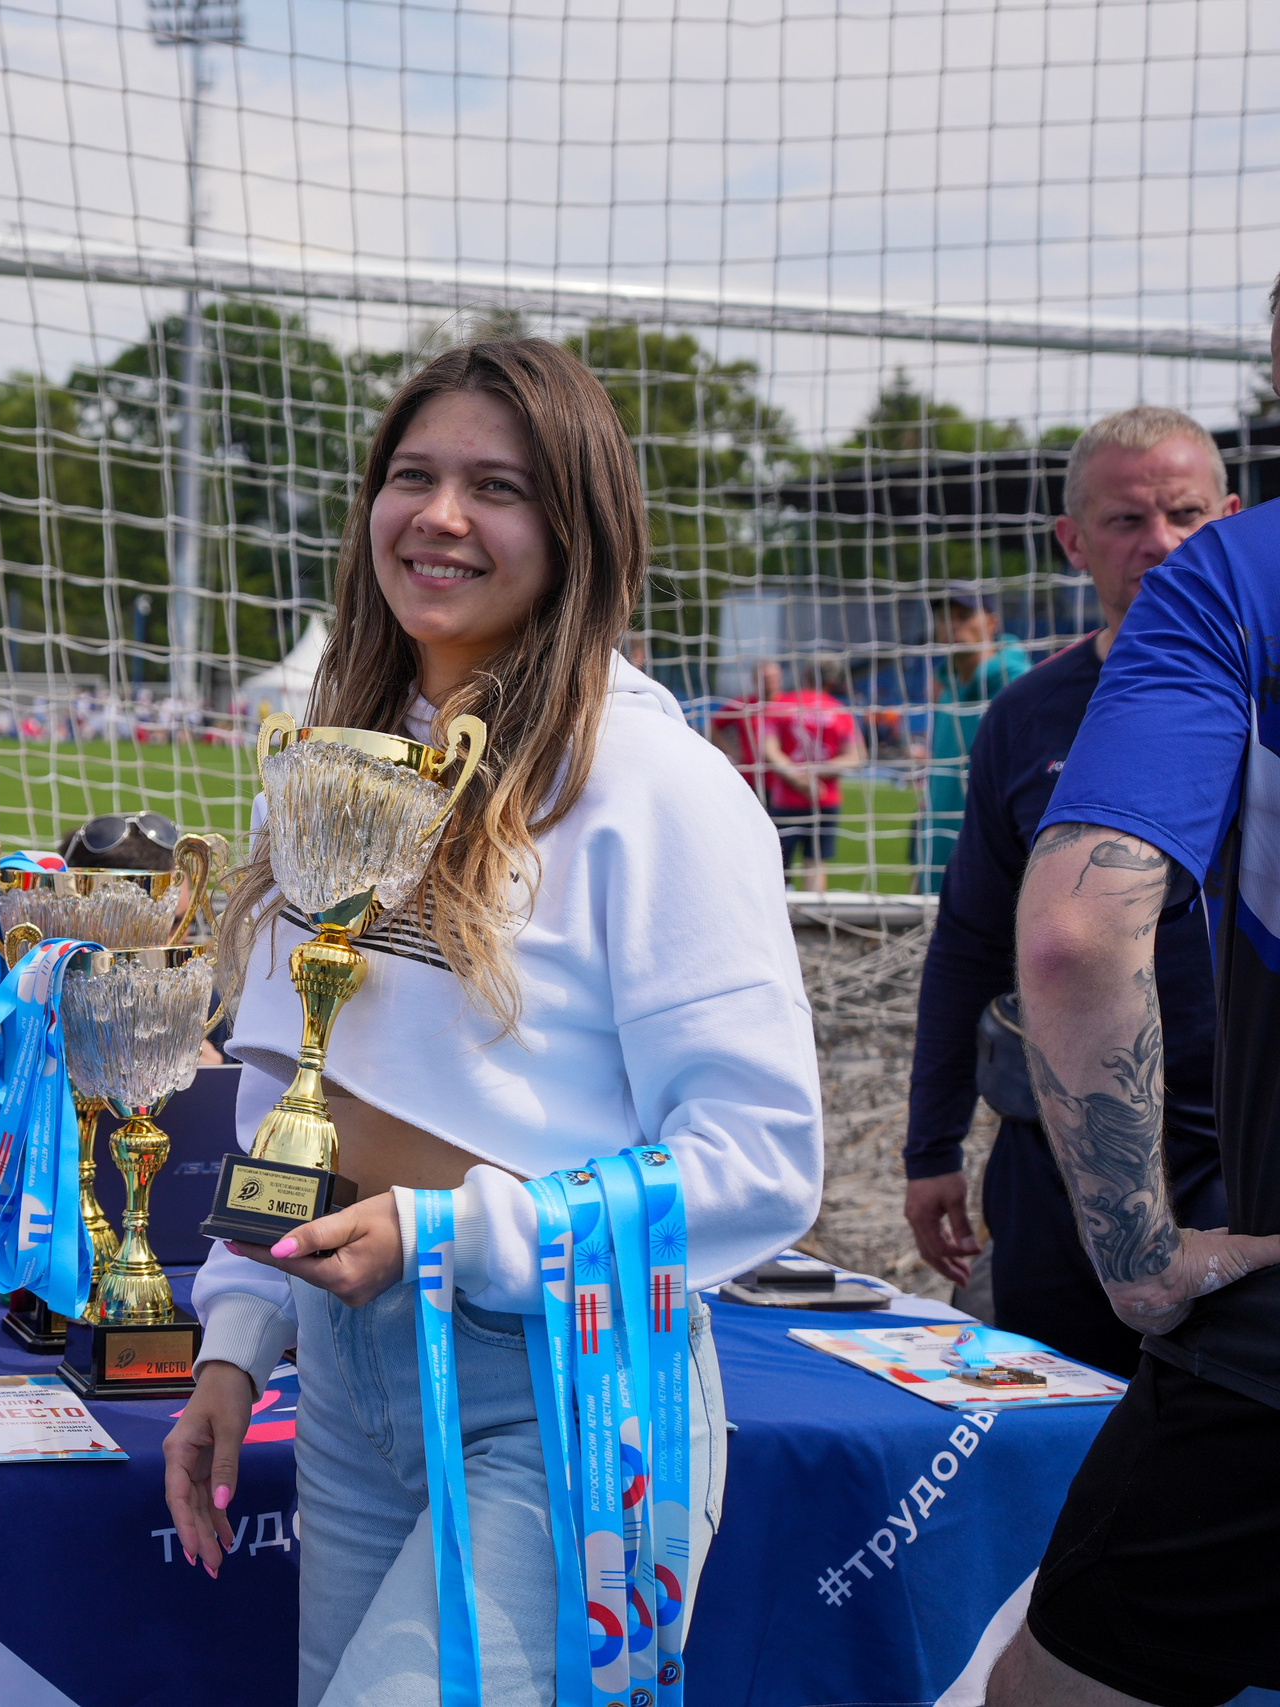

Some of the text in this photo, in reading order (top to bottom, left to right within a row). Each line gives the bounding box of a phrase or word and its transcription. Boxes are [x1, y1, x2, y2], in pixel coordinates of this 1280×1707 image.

[267, 1199, 275, 1212] 3
[276, 1200, 308, 1217] МЕСТО
[146, 1361, 187, 1374] 2 МЕСТО
[657, 1370, 666, 1404] ЛЕТНИЙ
[586, 1394, 600, 1513] ВСЕРОССИЙСКИЙ ЛЕТНИЙ
[601, 1373, 616, 1513] КОРПОРАТИВНЫЙ ФЕСТИВАЛЬ
[671, 1351, 683, 1484] КОРПОРАТИВНЫЙ ФЕСТИВАЛЬ
